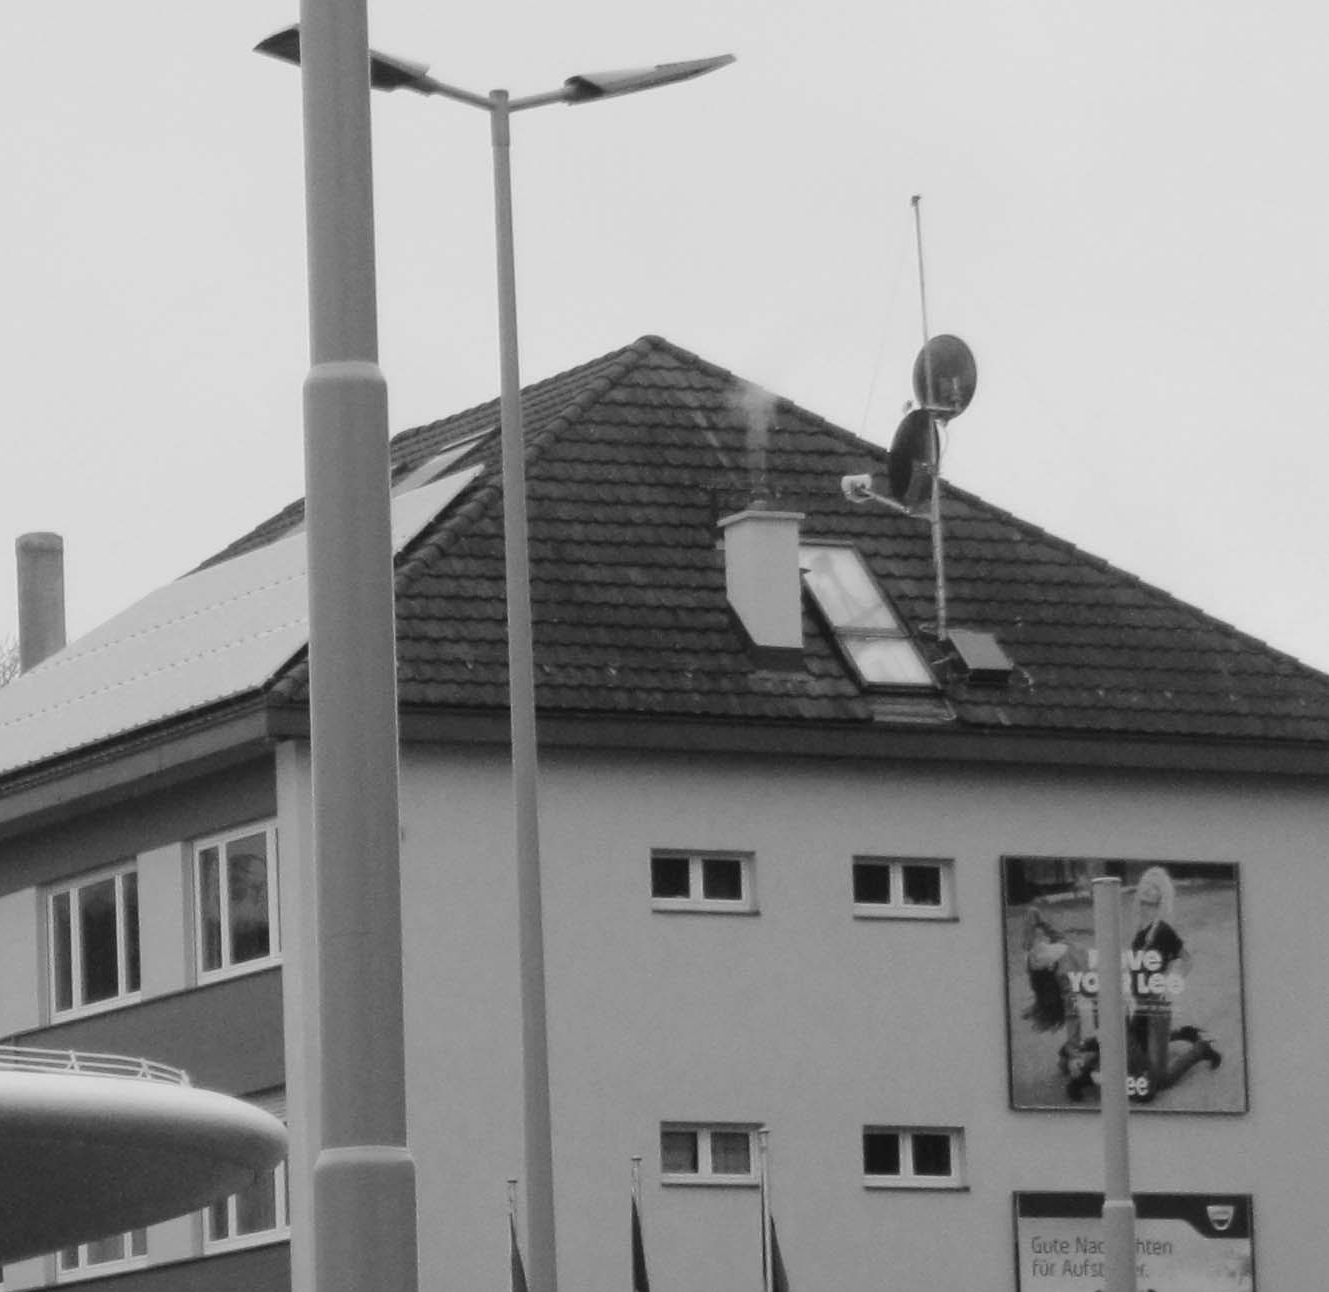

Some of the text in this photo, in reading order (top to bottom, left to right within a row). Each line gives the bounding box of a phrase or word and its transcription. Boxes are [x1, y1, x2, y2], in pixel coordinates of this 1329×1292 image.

[1068, 971, 1132, 994] YO
[1031, 1236, 1173, 1256] Gute Nachten
[1061, 1258, 1150, 1278] Aufstr.
